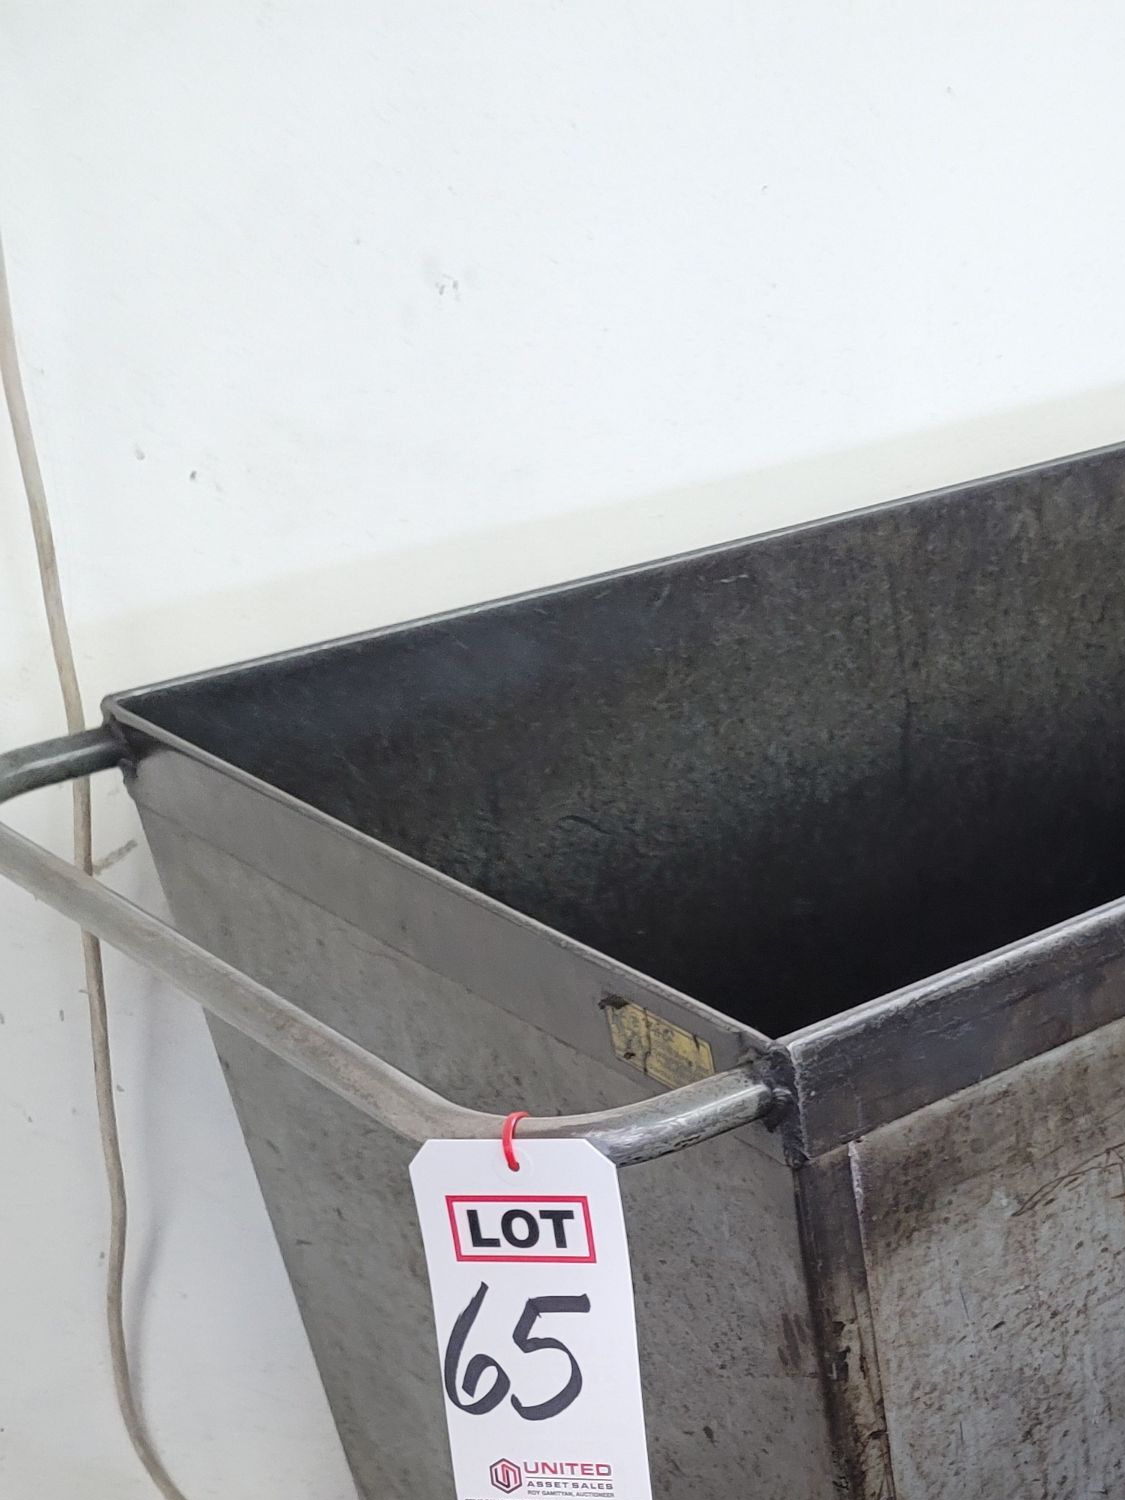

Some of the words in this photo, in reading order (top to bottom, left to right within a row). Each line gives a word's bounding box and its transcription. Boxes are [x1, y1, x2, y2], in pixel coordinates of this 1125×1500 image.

[467, 1209, 575, 1249] LOT
[444, 1281, 591, 1421] 65
[523, 1461, 612, 1477] UNITED
[527, 1480, 569, 1489] ASSET
[572, 1482, 614, 1490] SALES
